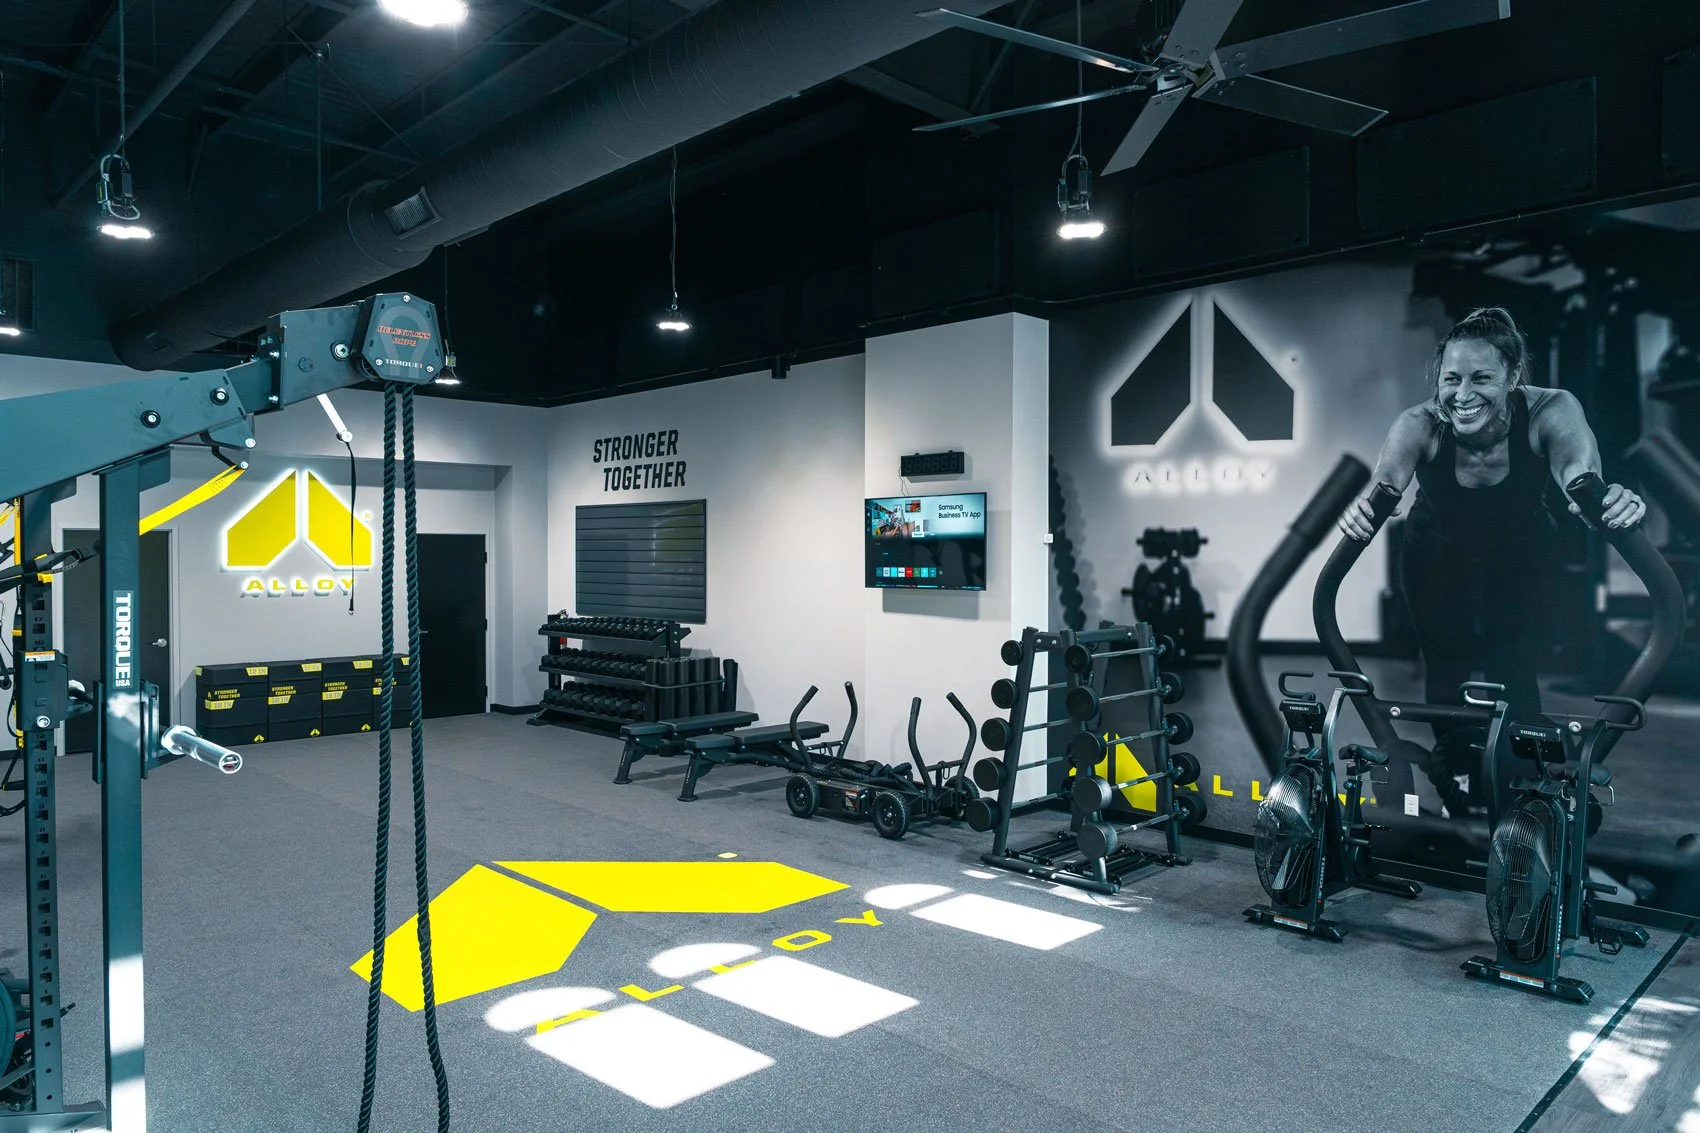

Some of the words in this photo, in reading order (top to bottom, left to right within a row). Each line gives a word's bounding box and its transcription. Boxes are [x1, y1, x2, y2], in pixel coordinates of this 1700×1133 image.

[593, 429, 679, 463] STRONGER
[603, 460, 687, 492] TOGETHER
[969, 511, 982, 519] App
[246, 578, 355, 592] ALLOY
[115, 592, 132, 680] TORQUE
[115, 679, 131, 687] USA
